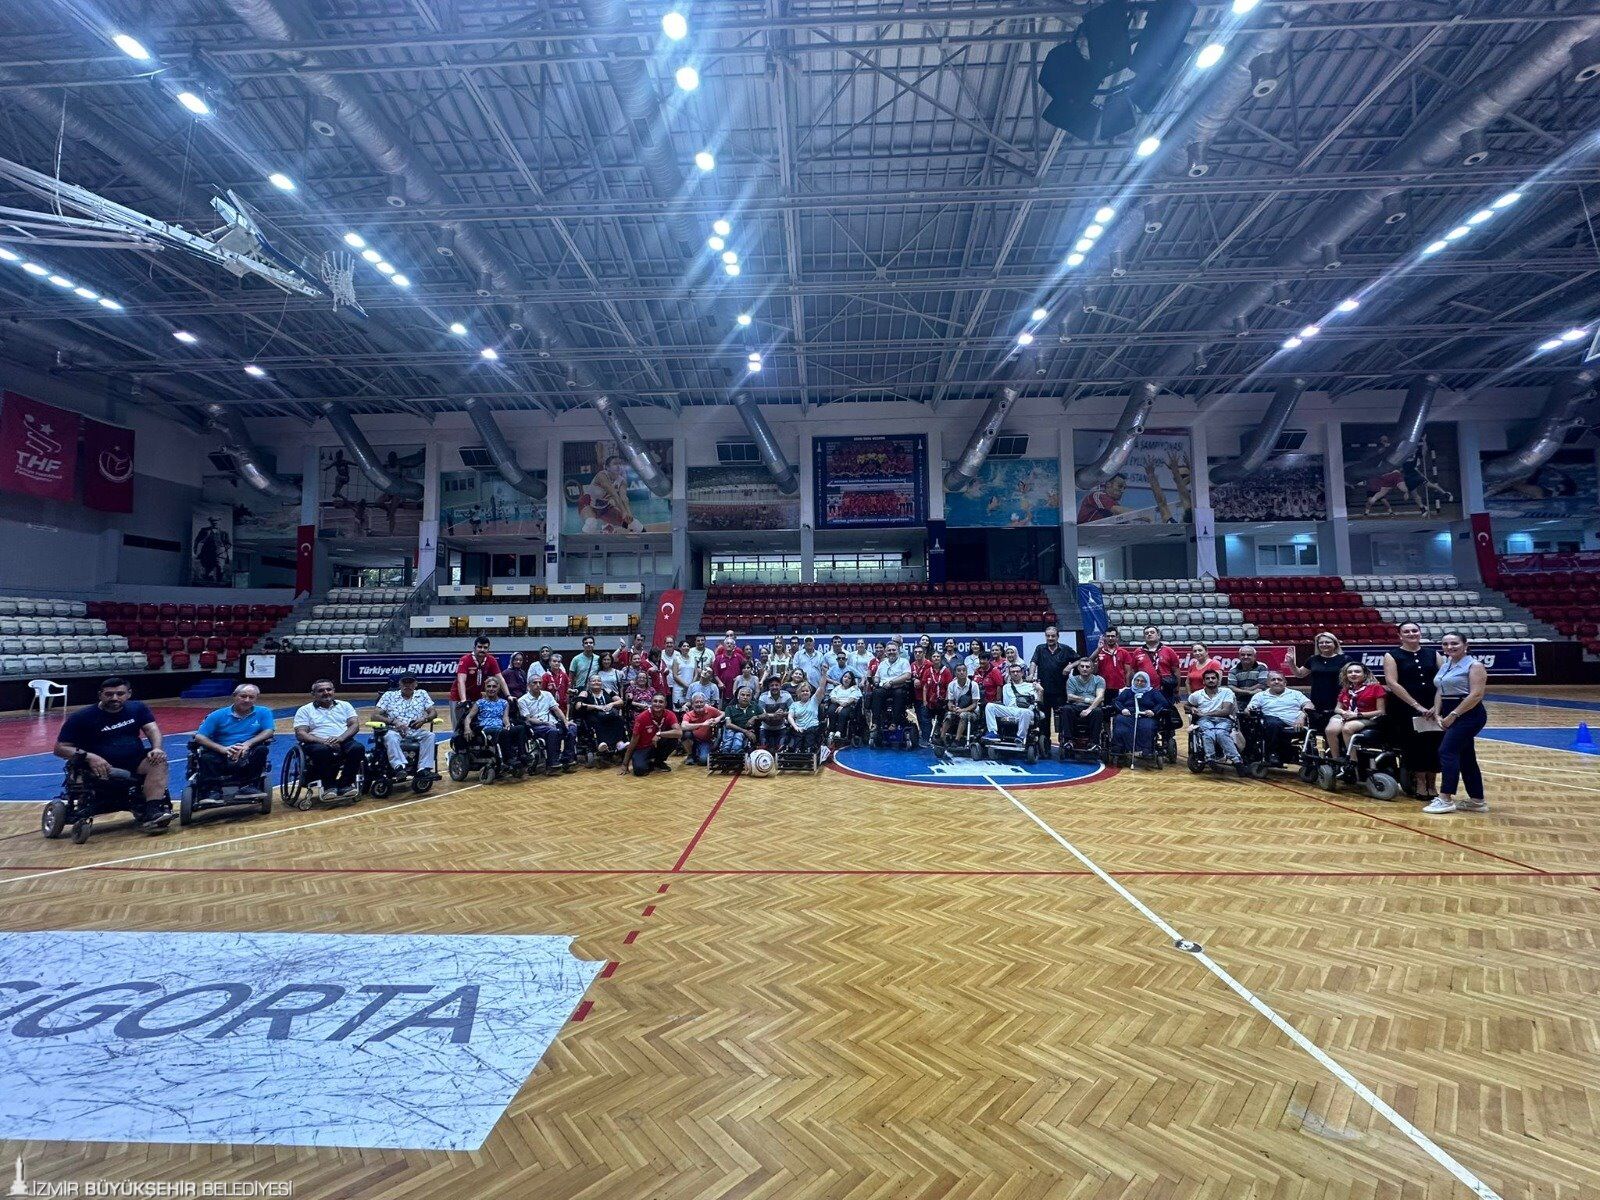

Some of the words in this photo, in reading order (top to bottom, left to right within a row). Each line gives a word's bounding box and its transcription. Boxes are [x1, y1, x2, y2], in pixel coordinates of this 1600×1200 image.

[16, 450, 62, 472] THF
[407, 664, 423, 674] EN
[425, 661, 461, 674] BÜYÜ
[111, 718, 135, 730] adidas
